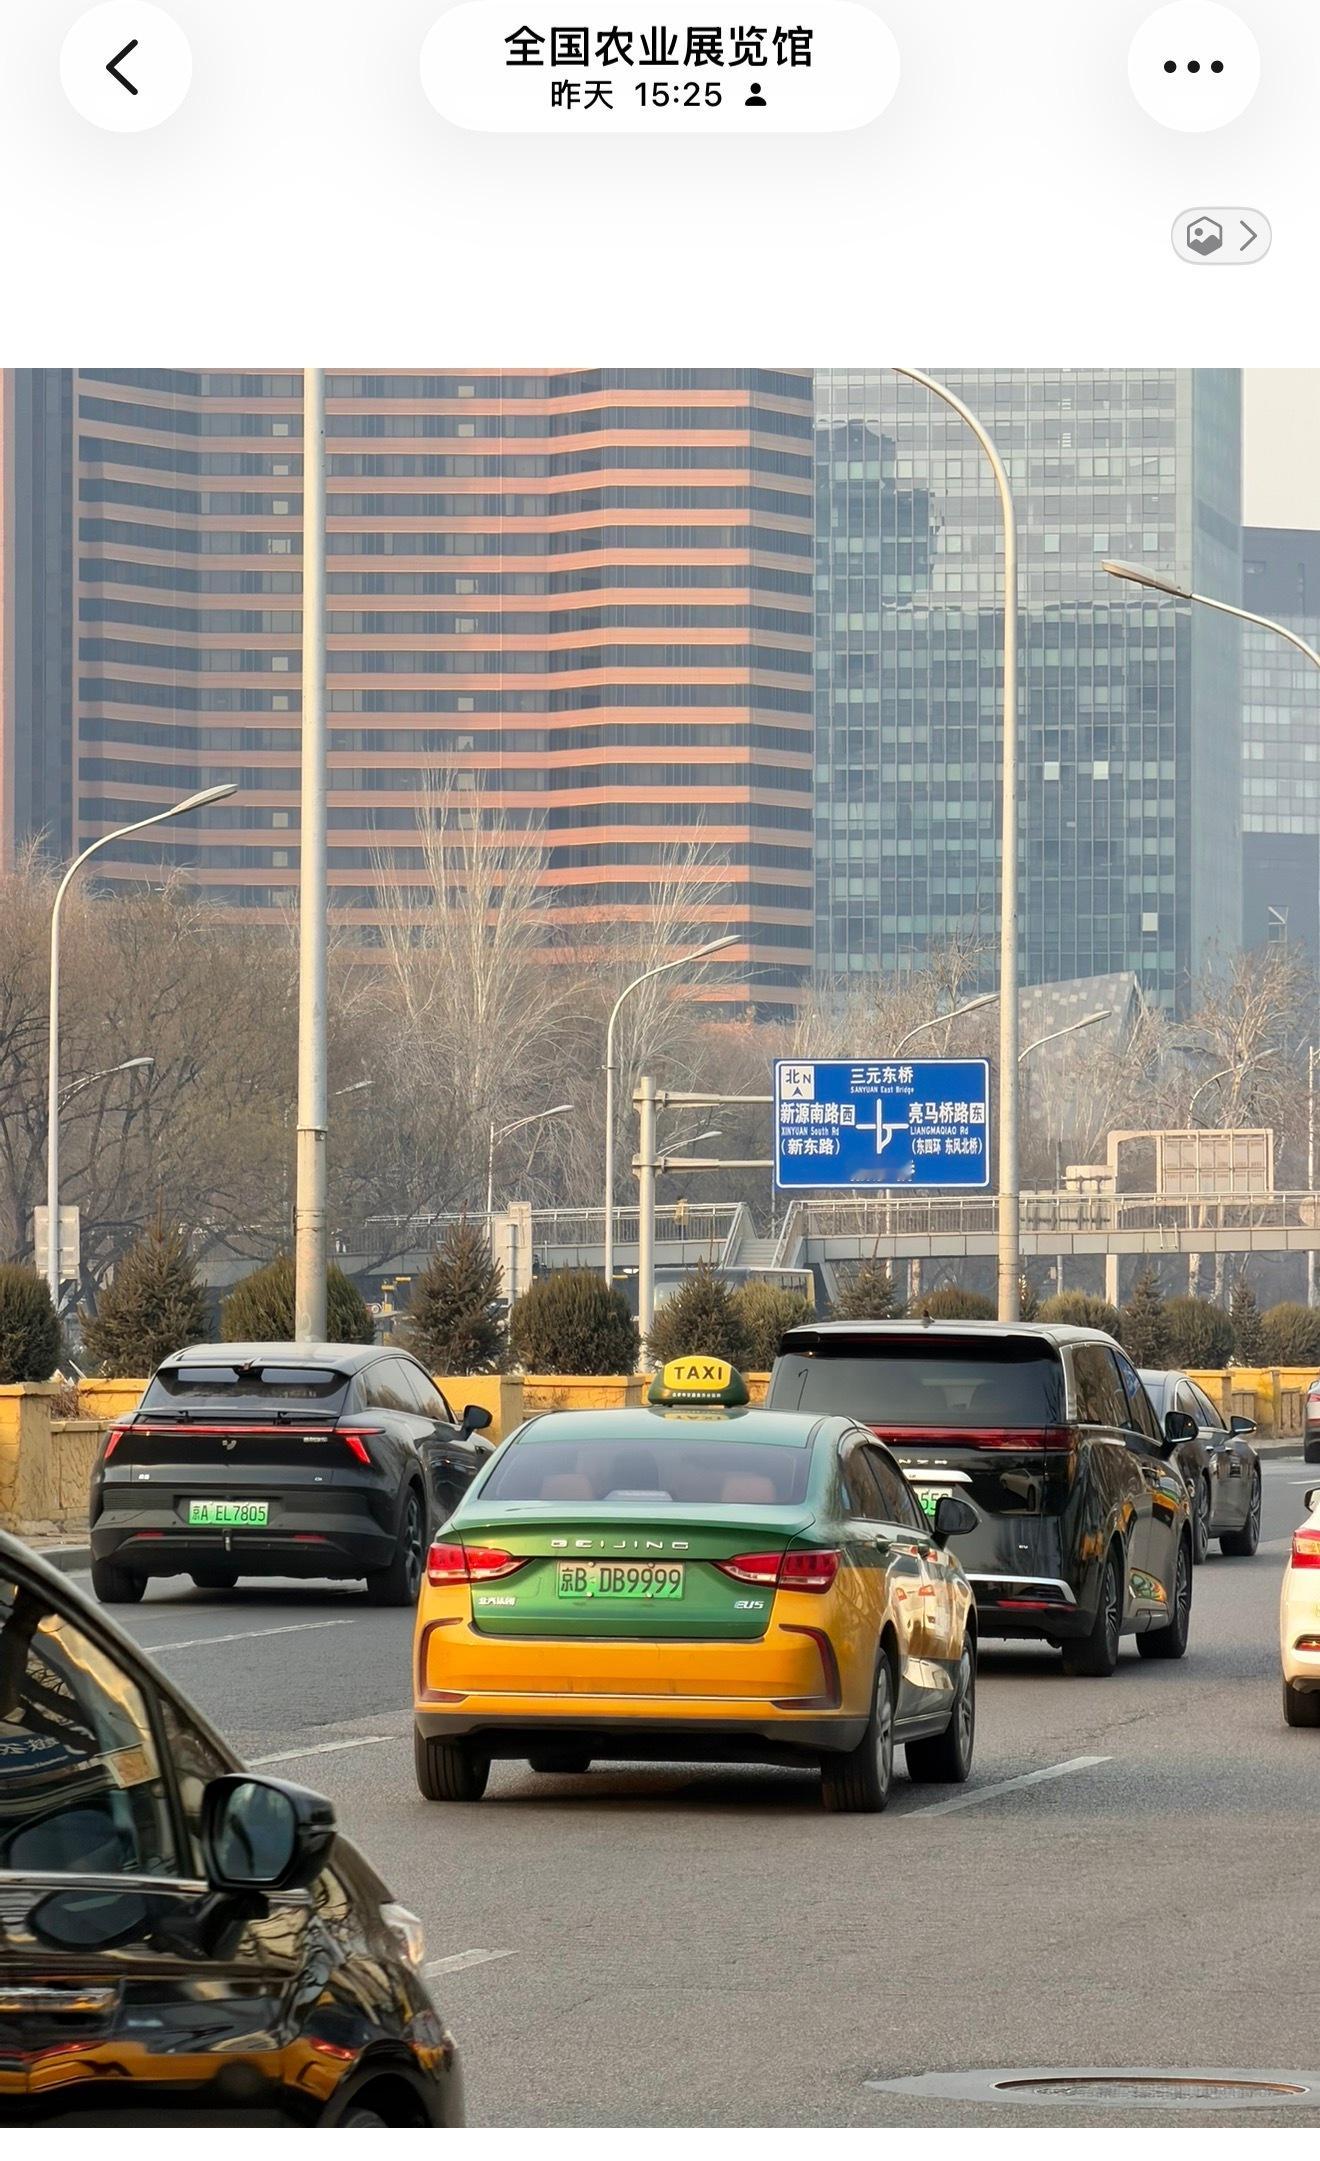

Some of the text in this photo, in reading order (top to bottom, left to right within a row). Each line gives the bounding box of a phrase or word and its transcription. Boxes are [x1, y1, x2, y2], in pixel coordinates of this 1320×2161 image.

[785, 1069, 811, 1084] 北 N
[850, 1066, 914, 1084] 三元东桥
[674, 1366, 723, 1380] TAXI
[551, 1539, 689, 1549] BEIJING
